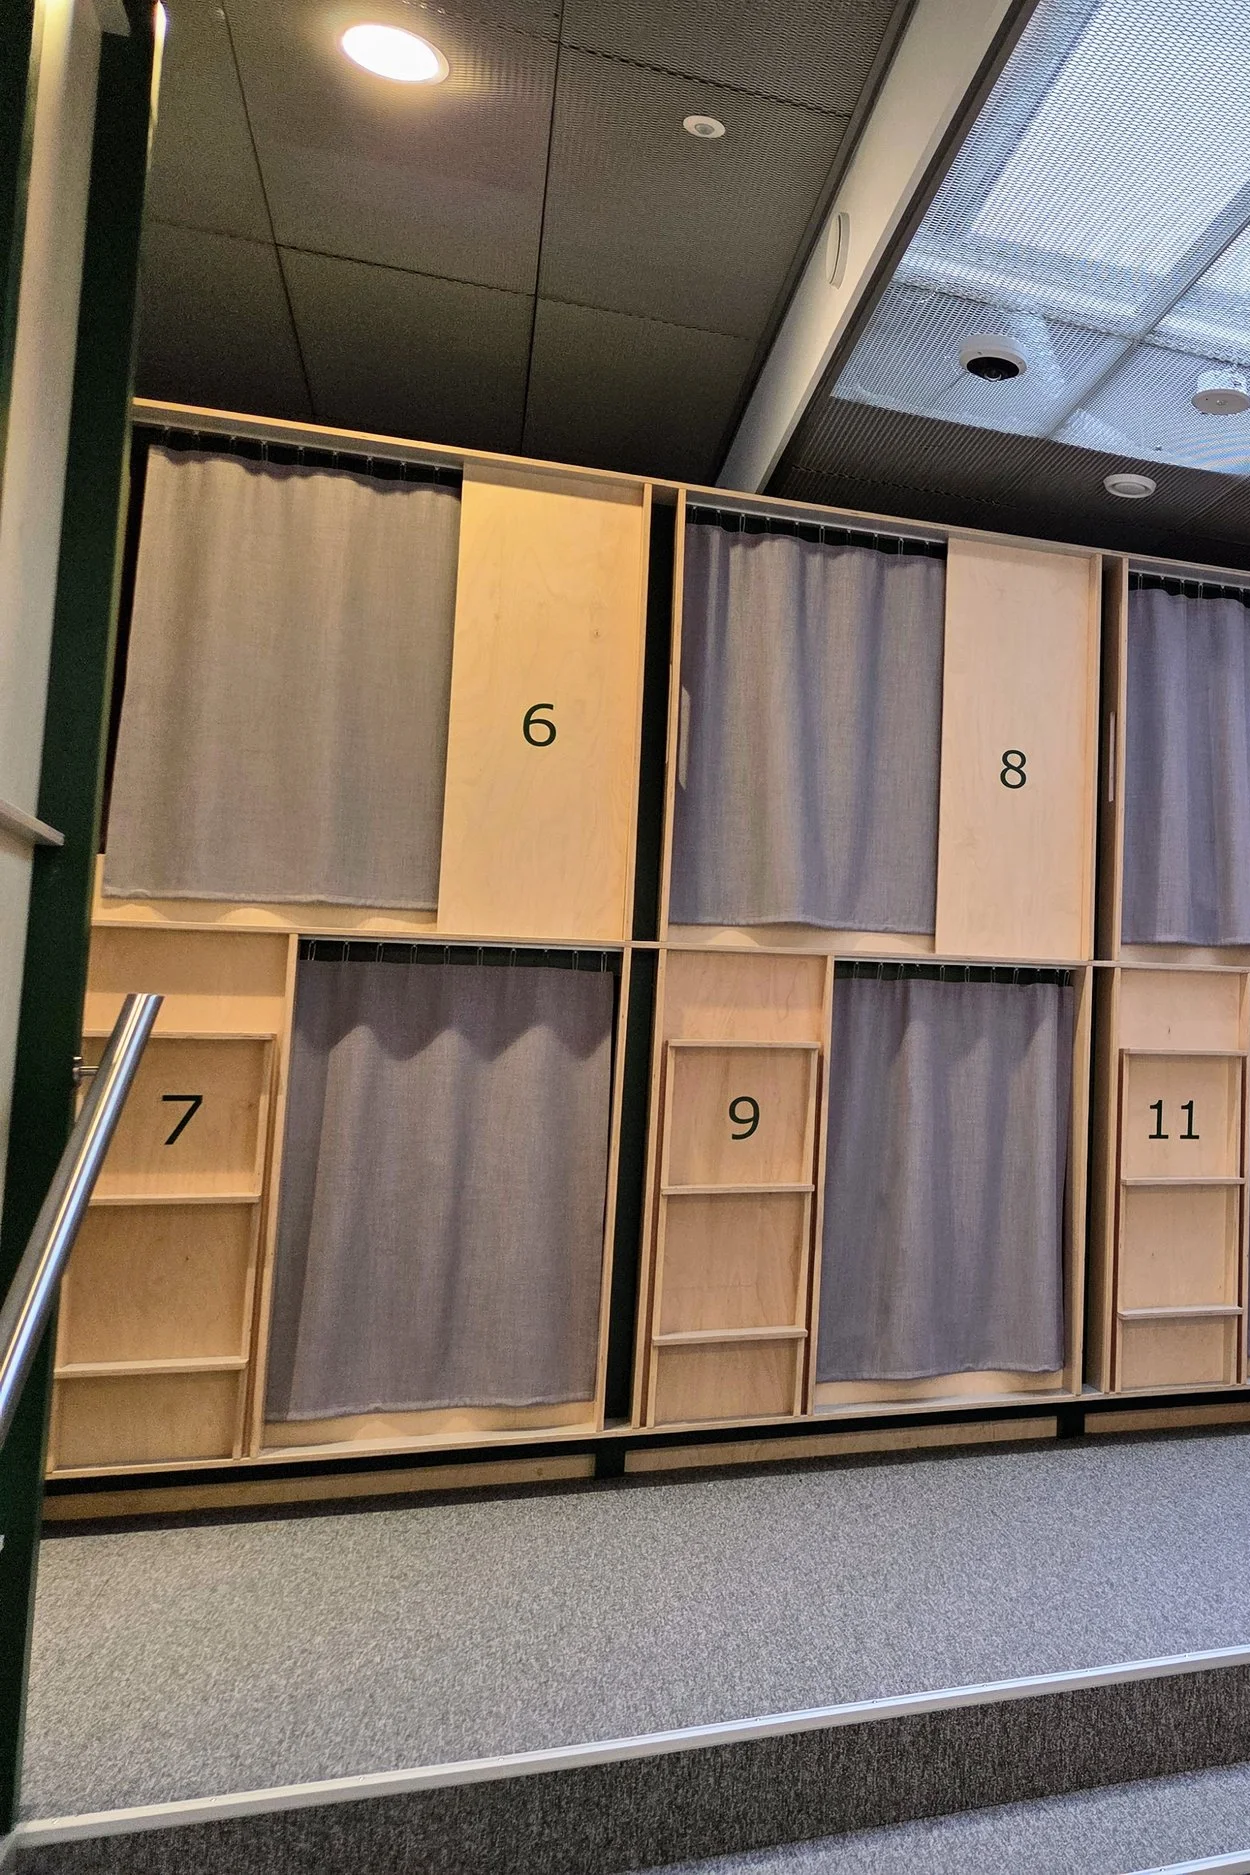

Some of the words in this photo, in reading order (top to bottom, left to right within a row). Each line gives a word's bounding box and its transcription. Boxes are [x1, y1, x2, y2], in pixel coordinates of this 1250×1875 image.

[522, 703, 557, 747] 6
[1000, 749, 1027, 790] 8
[161, 1094, 203, 1146] 7
[728, 1096, 760, 1140] 9
[1148, 1099, 1200, 1140] 11
